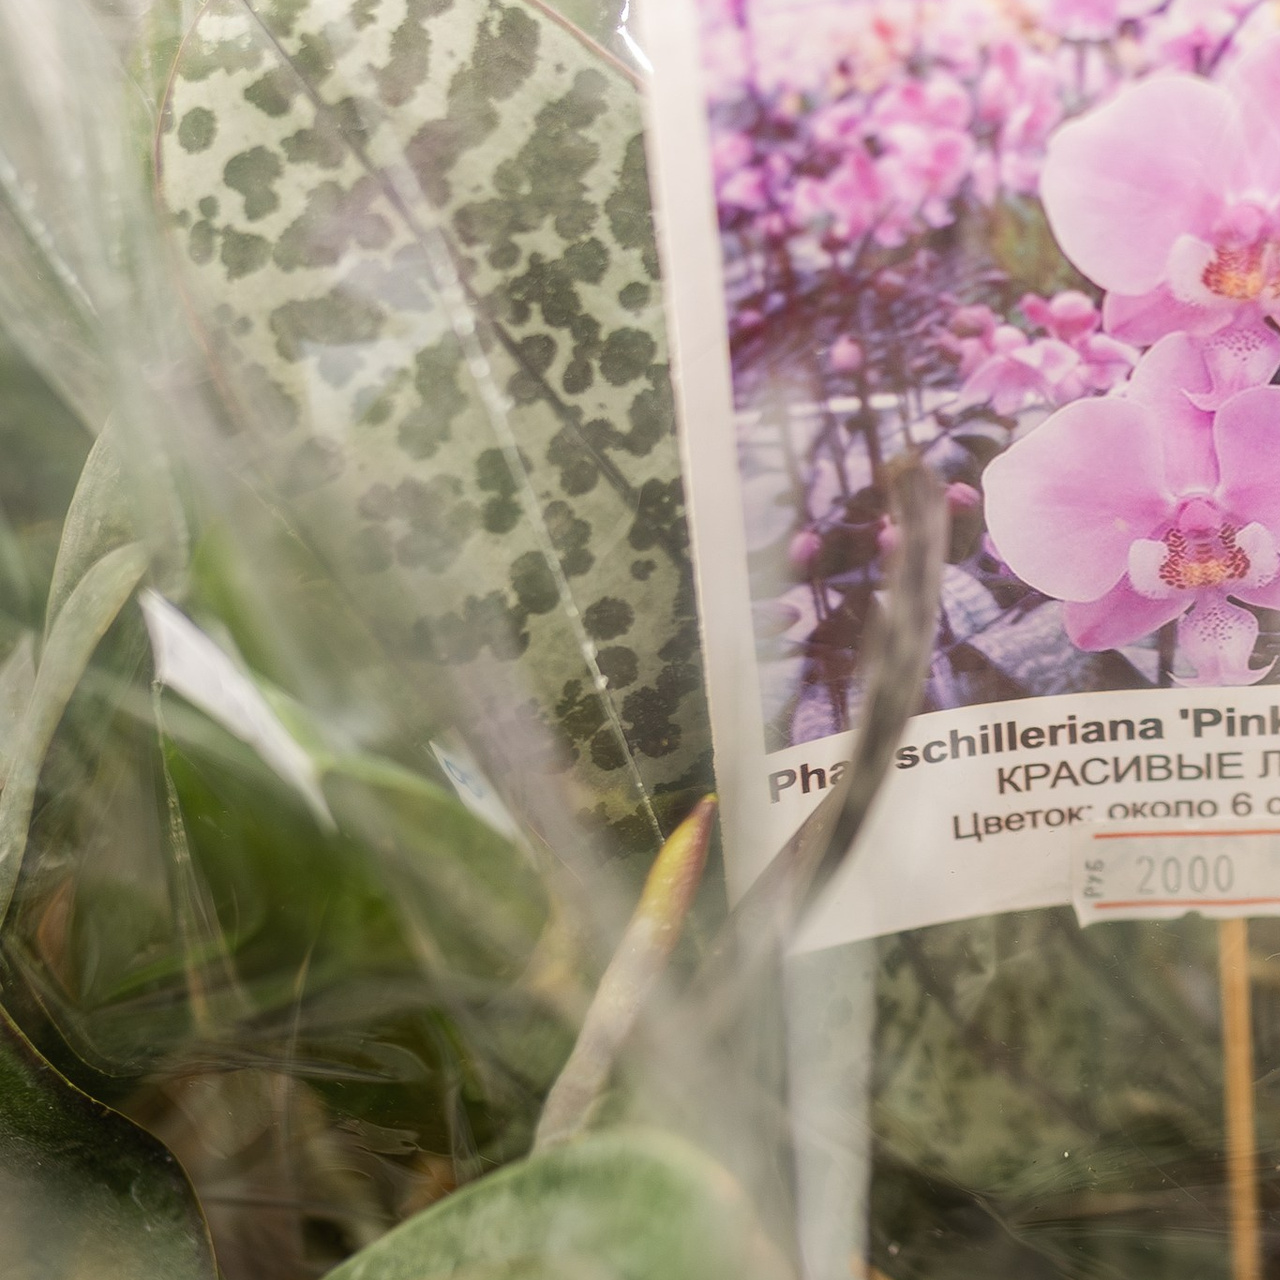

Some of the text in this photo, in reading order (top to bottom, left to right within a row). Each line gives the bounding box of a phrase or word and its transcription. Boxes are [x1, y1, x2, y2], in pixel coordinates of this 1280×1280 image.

[895, 716, 1165, 770] schilleriana
[997, 752, 1245, 795] КРАСИВЫЕ
[1107, 798, 1219, 819] около
[1231, 792, 1253, 818] 6
[1135, 853, 1236, 895] 2000
